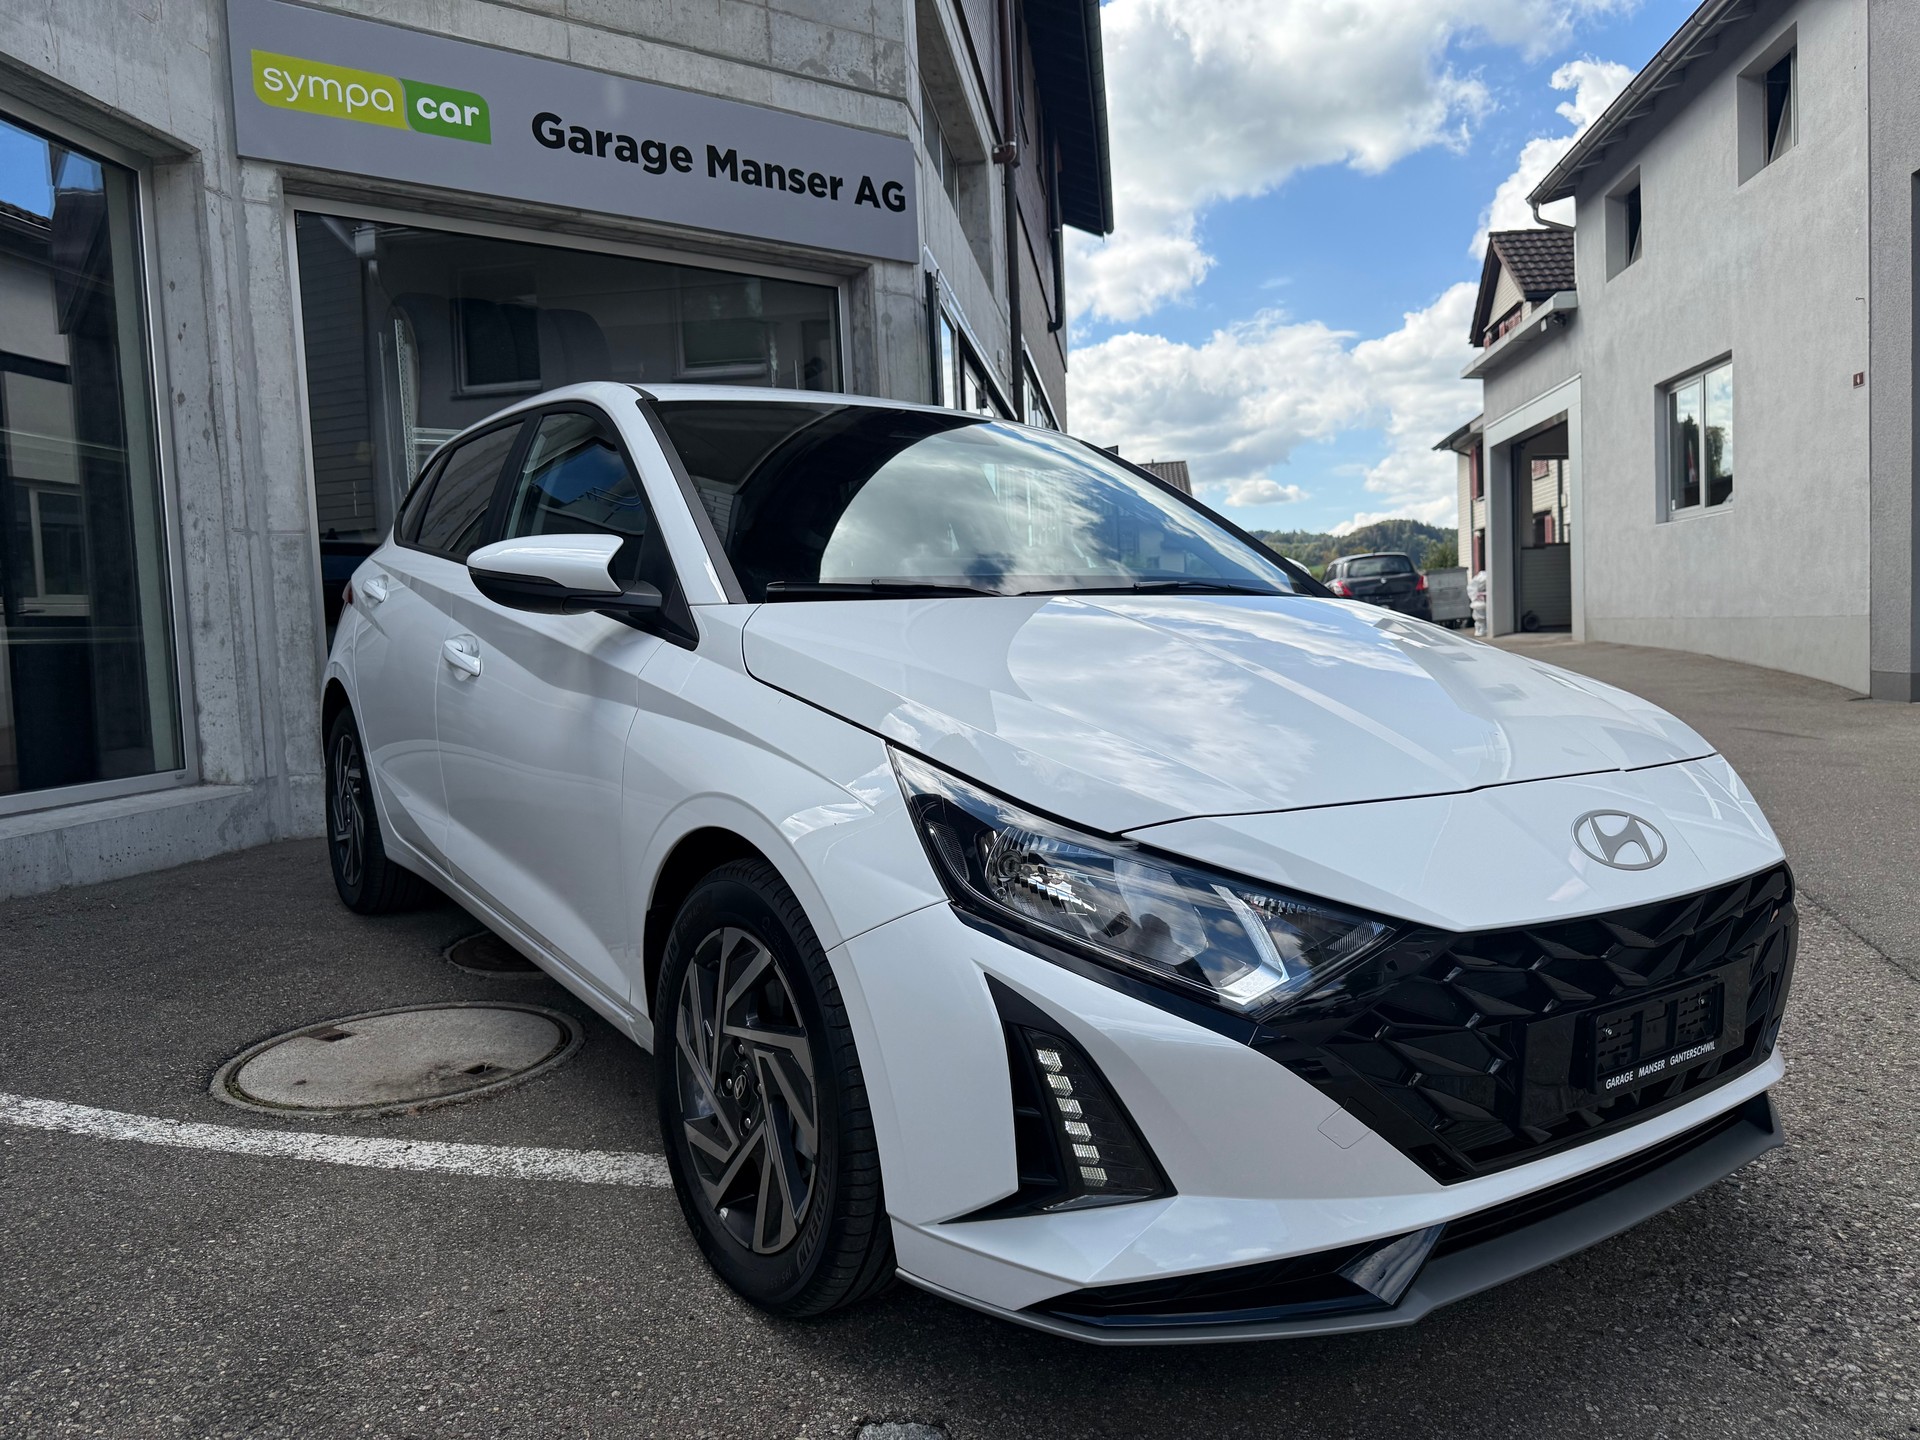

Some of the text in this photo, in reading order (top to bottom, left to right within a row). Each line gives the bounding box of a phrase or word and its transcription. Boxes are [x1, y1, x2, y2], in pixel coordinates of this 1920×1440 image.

[262, 66, 480, 127] sympa car
[531, 111, 906, 212] Garage Manser AG
[1605, 1040, 1716, 1090] GARAGE MANSER GANTERSCHWIL
